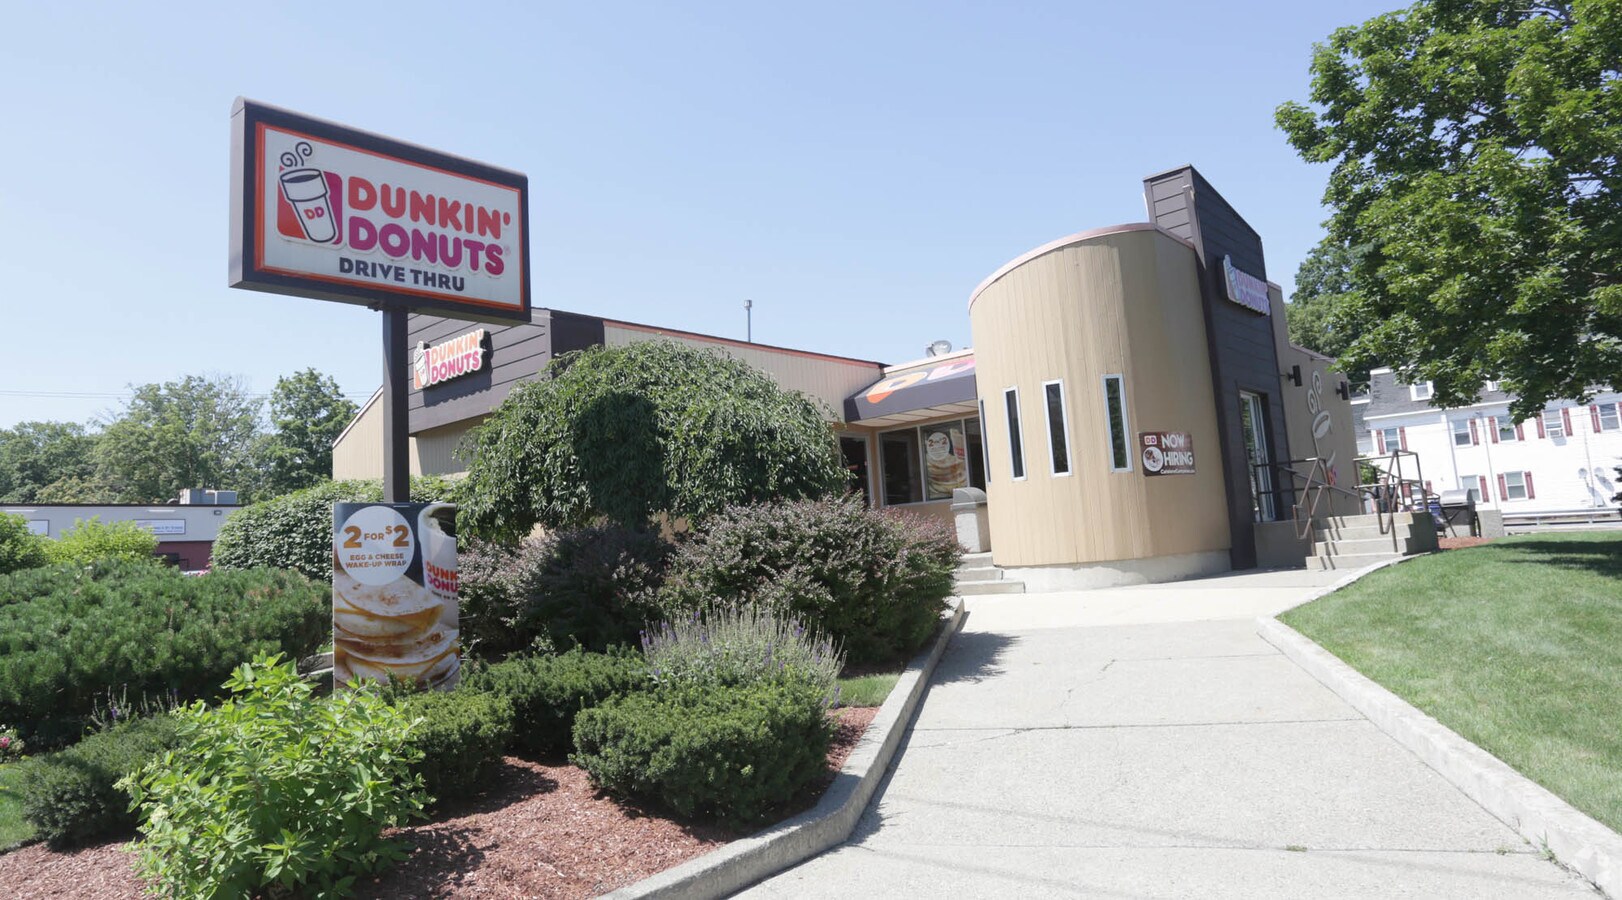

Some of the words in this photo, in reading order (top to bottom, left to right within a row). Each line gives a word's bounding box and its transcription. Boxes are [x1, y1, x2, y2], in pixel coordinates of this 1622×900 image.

[348, 176, 511, 240] DUNKIN'
[348, 216, 505, 276] DONUTS
[339, 257, 405, 283] DRIVE
[410, 269, 465, 291] THRU
[431, 330, 484, 365] DUNKIN'
[431, 350, 480, 382] DONUTS
[1161, 434, 1185, 448] NOW
[1163, 451, 1193, 466] HIRING
[343, 525, 362, 548] 2
[364, 532, 385, 540] FOR
